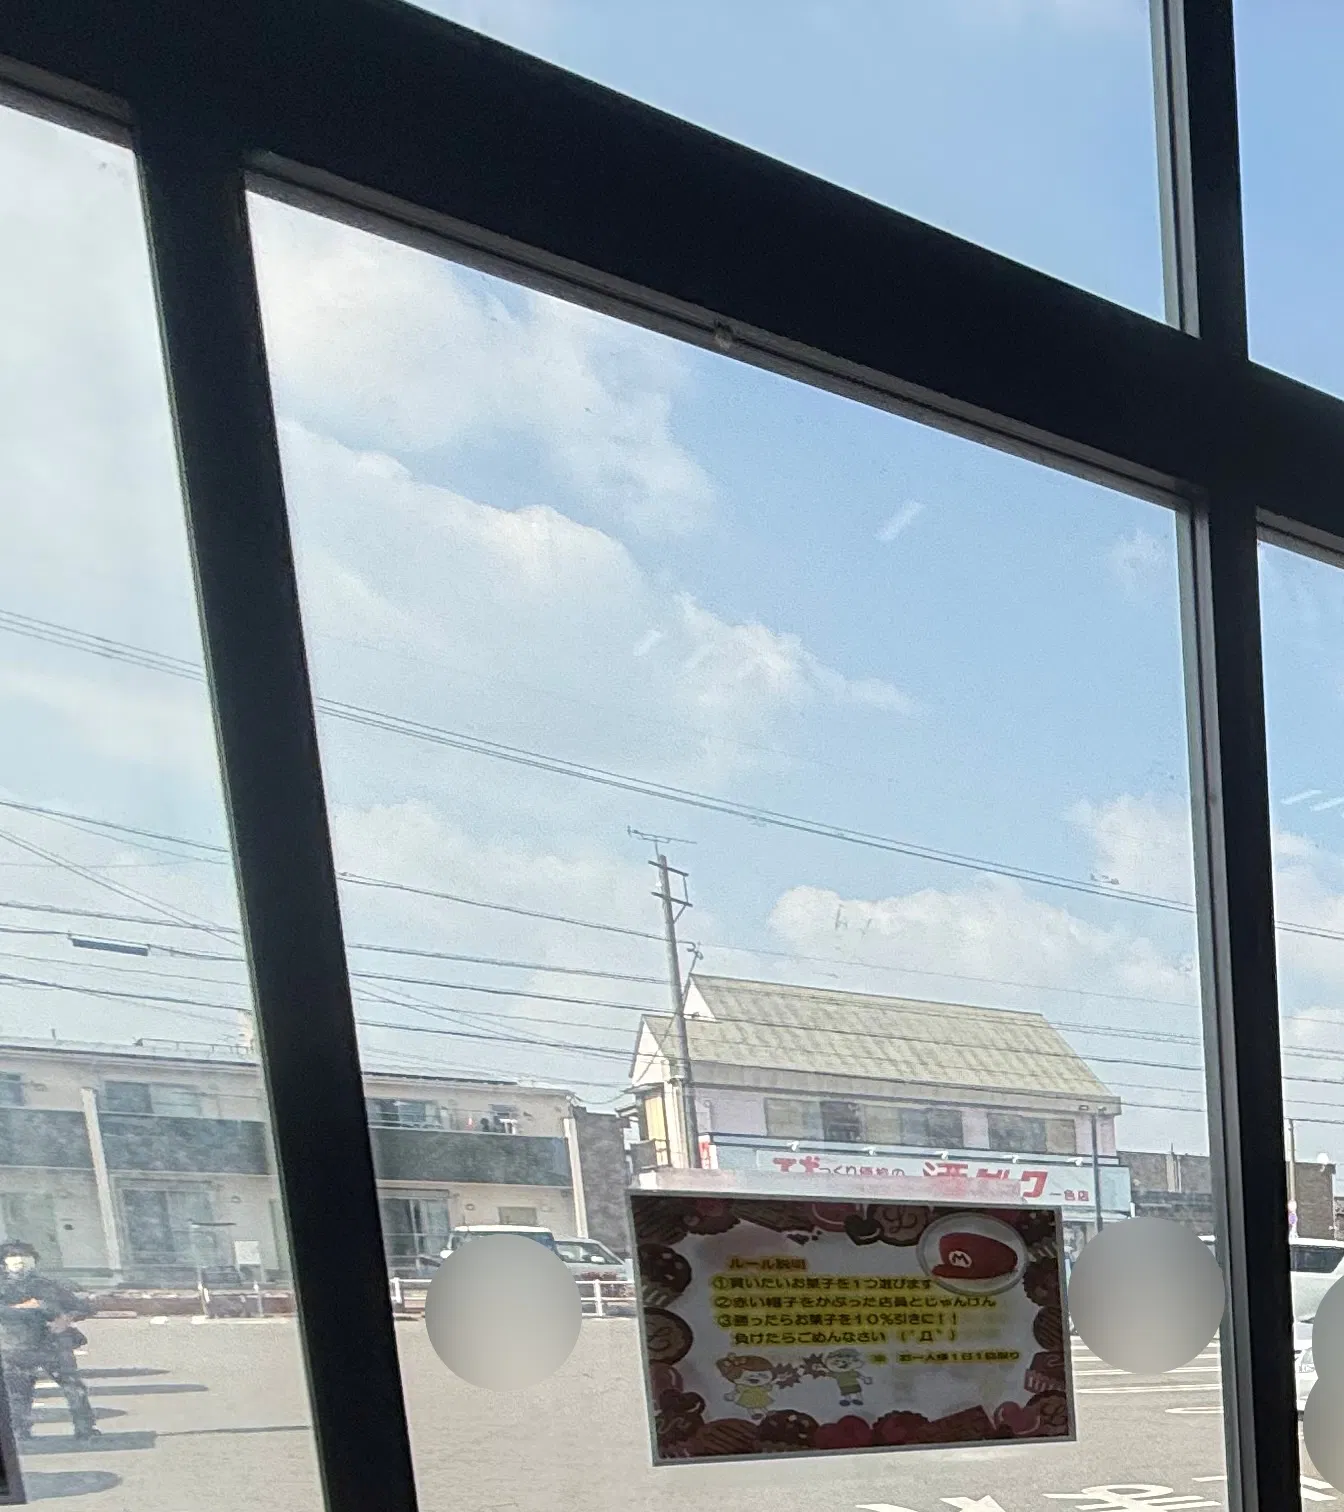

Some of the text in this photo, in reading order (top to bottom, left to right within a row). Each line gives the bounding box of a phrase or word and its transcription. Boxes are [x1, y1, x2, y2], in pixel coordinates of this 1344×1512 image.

[729, 1257, 807, 1270] ルール説明
[734, 1331, 886, 1344] 負けたらごめんなさい
